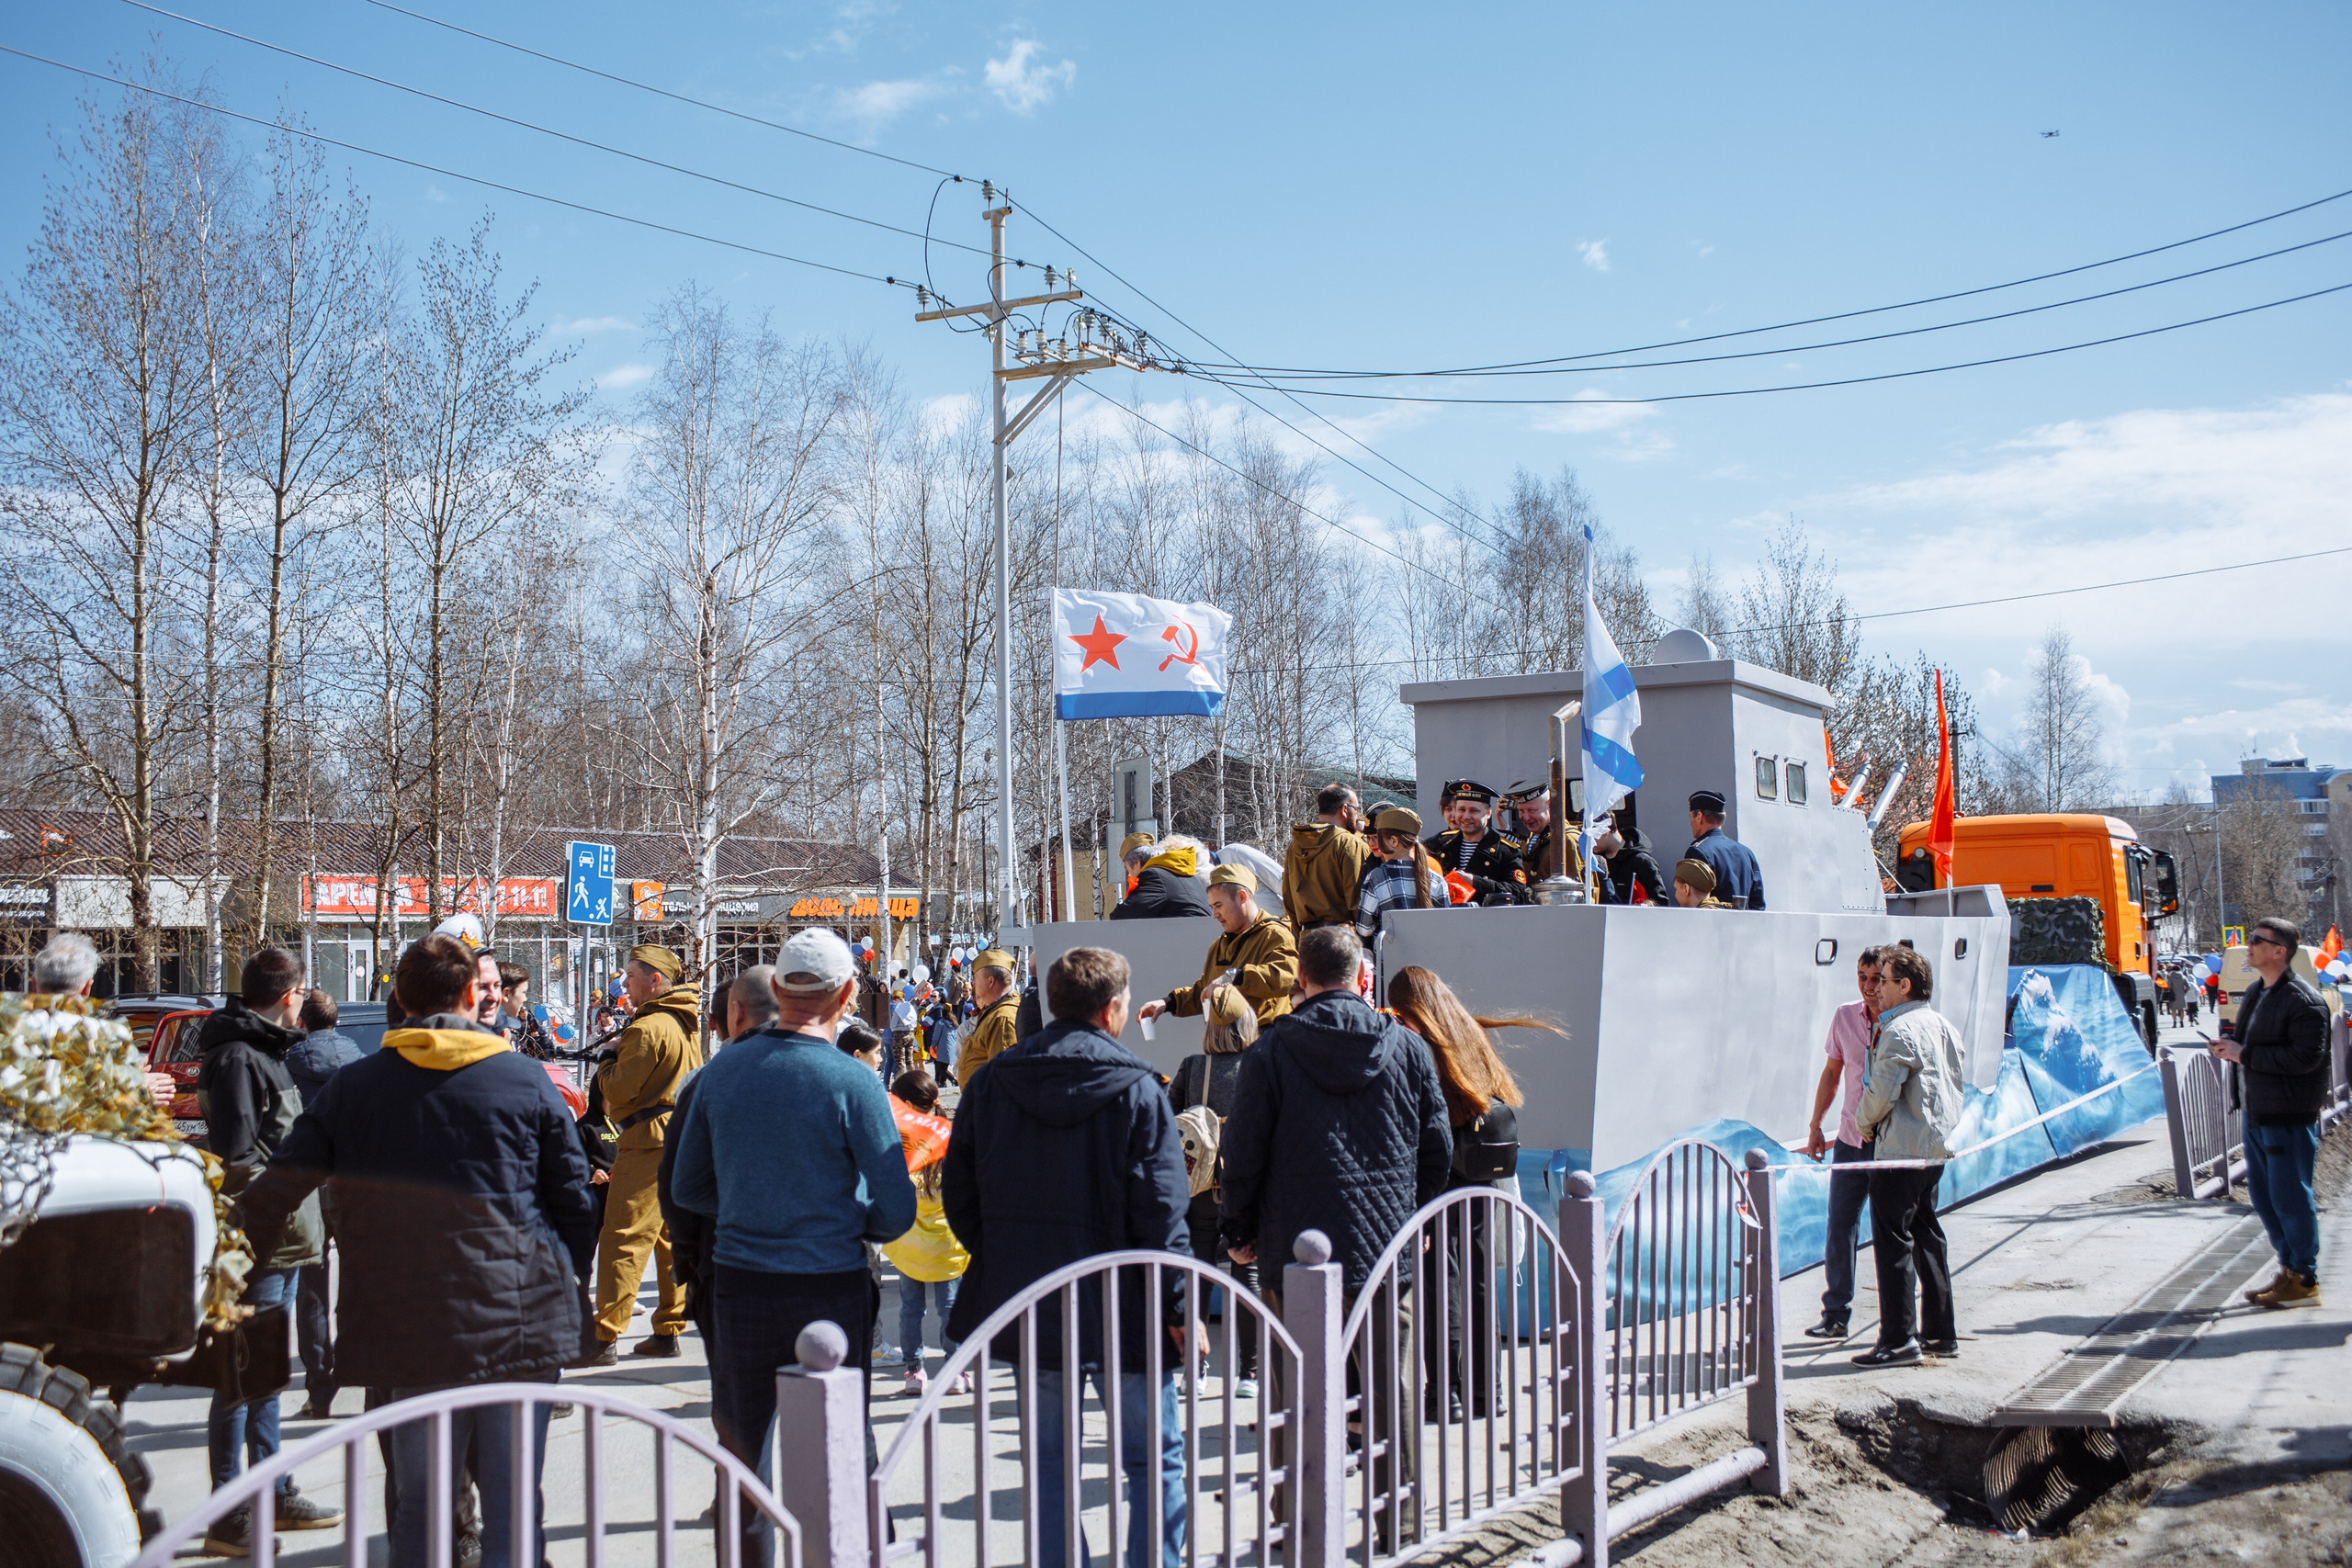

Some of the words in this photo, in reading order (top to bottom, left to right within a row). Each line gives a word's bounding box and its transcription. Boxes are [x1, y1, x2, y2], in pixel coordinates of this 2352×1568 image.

[315, 882, 413, 907] АРЕНА
[175, 1122, 197, 1133] 45ХМ
[910, 1116, 951, 1141] МАЯ
